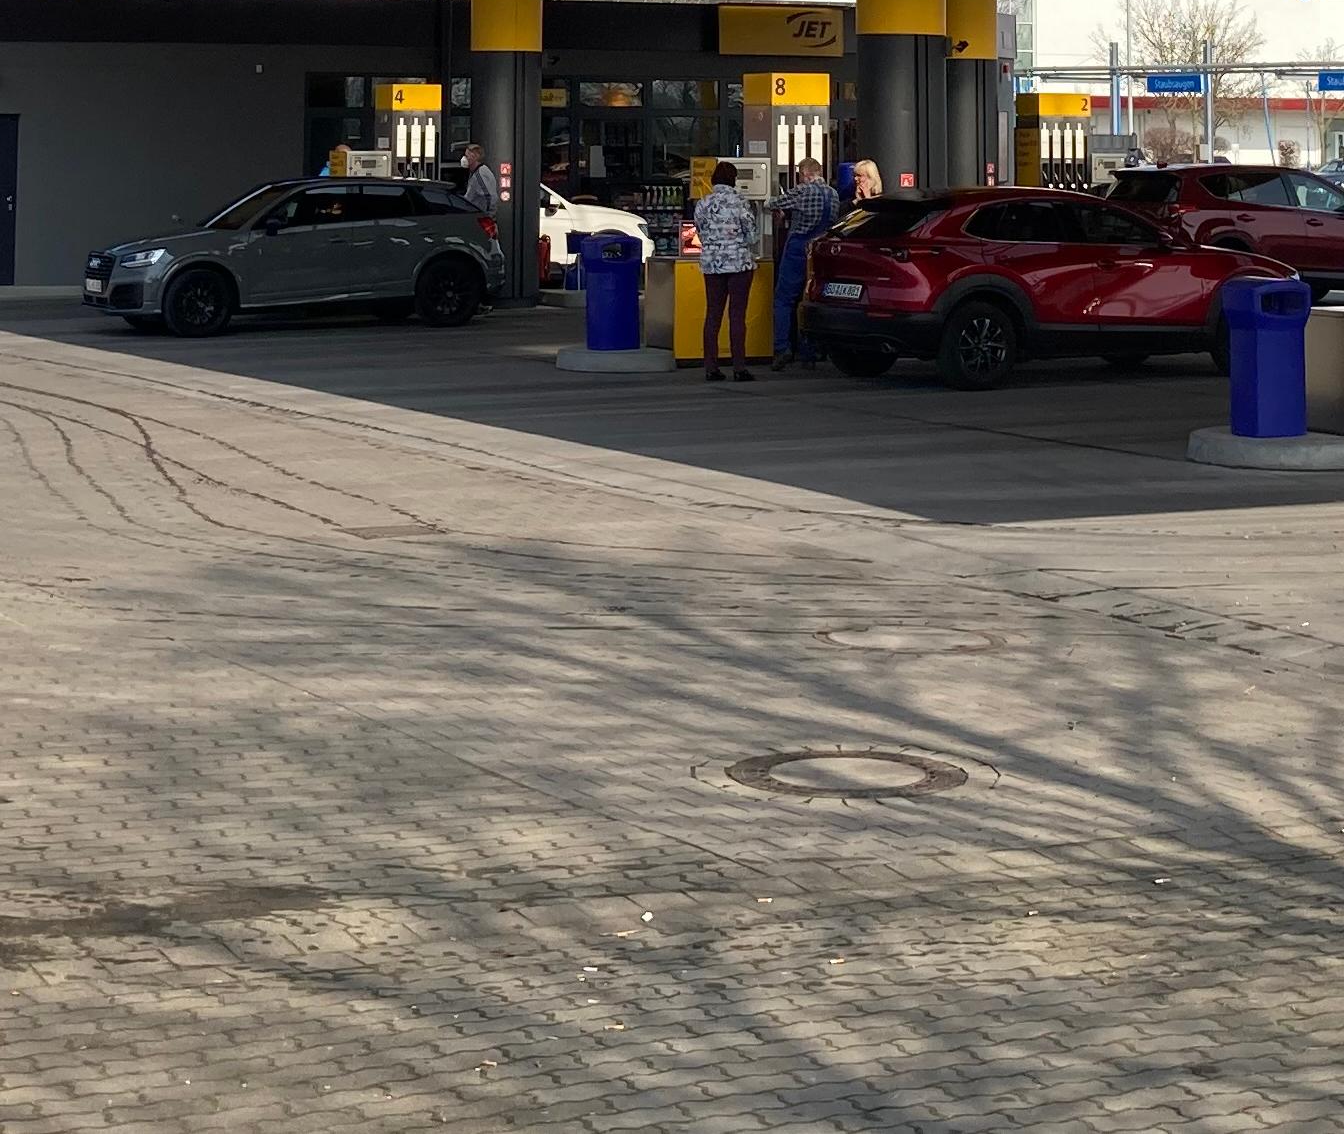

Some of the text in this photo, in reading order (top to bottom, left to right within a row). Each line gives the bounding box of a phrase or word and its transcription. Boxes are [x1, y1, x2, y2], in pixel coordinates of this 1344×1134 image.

[793, 21, 832, 38] JET
[775, 78, 786, 96] 8
[1154, 79, 1196, 90] Staubsaugen
[394, 89, 405, 104] 4
[1081, 98, 1089, 112] 2
